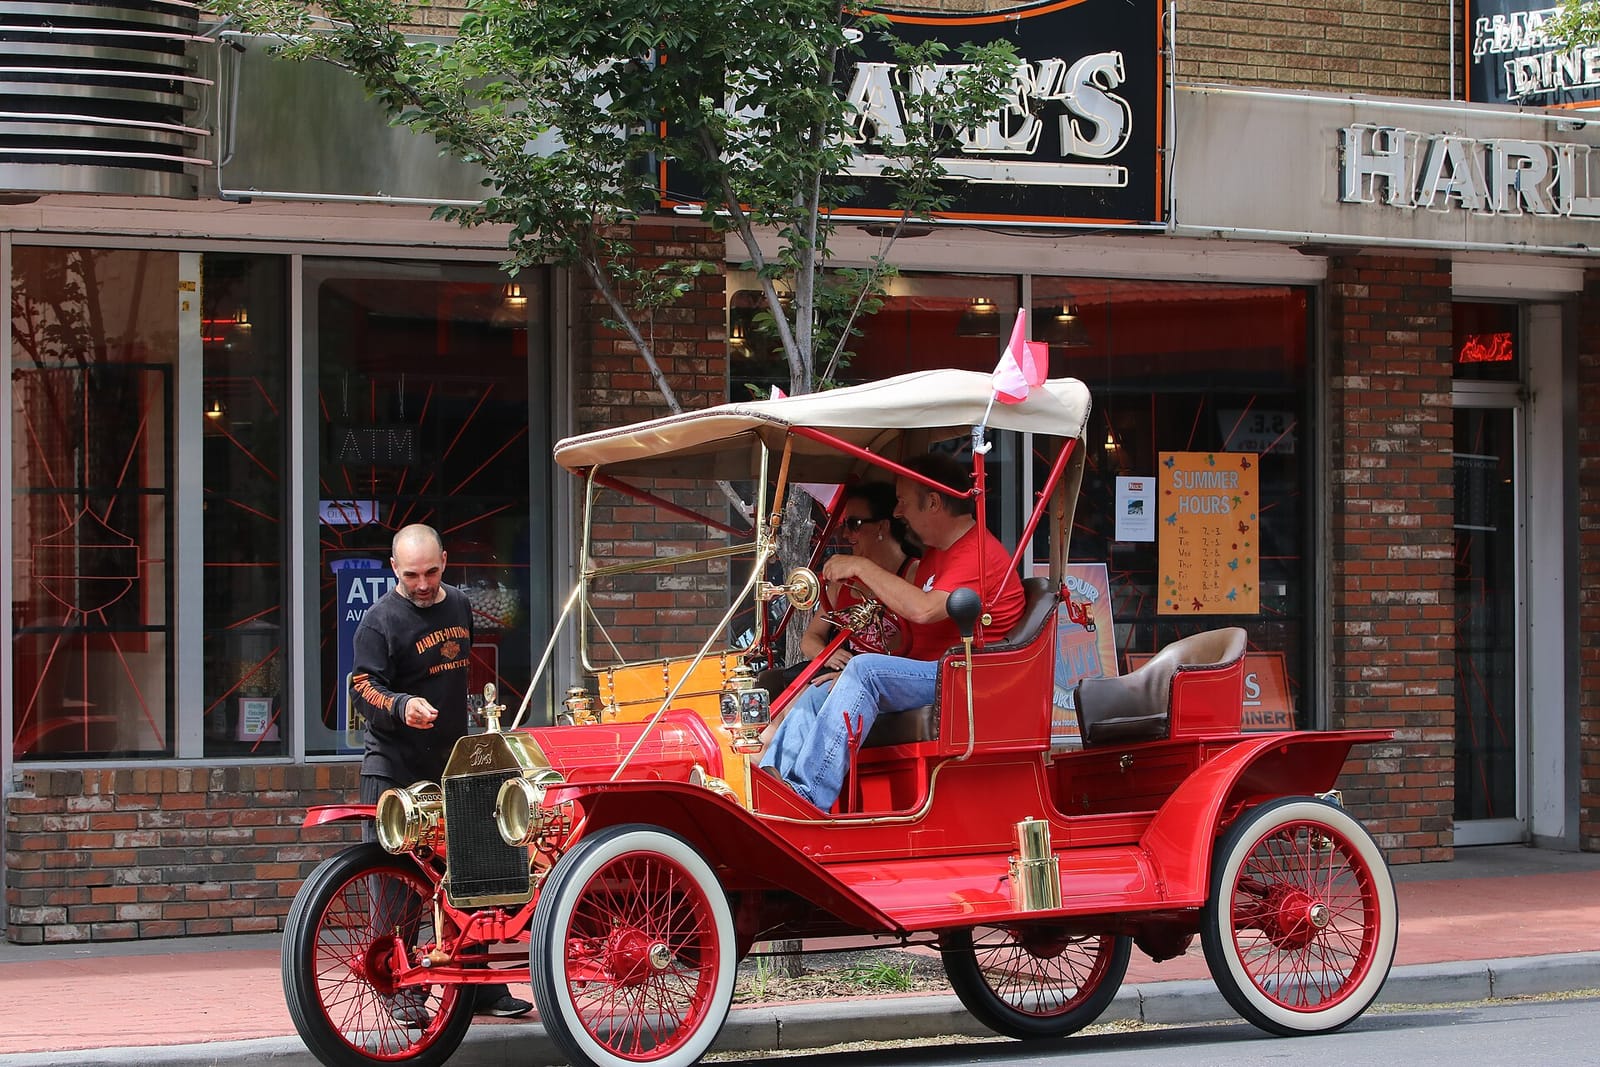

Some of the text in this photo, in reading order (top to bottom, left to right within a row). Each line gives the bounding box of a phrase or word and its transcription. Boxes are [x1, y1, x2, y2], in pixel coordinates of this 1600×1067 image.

[338, 428, 413, 461] ATM
[1172, 470, 1240, 490] SUMMER
[1178, 495, 1231, 515] HOURS
[343, 560, 371, 569] ATM
[1065, 575, 1100, 602] OUR
[1244, 673, 1261, 699] S
[1241, 711, 1287, 726] INER
[469, 743, 493, 767] Ford
